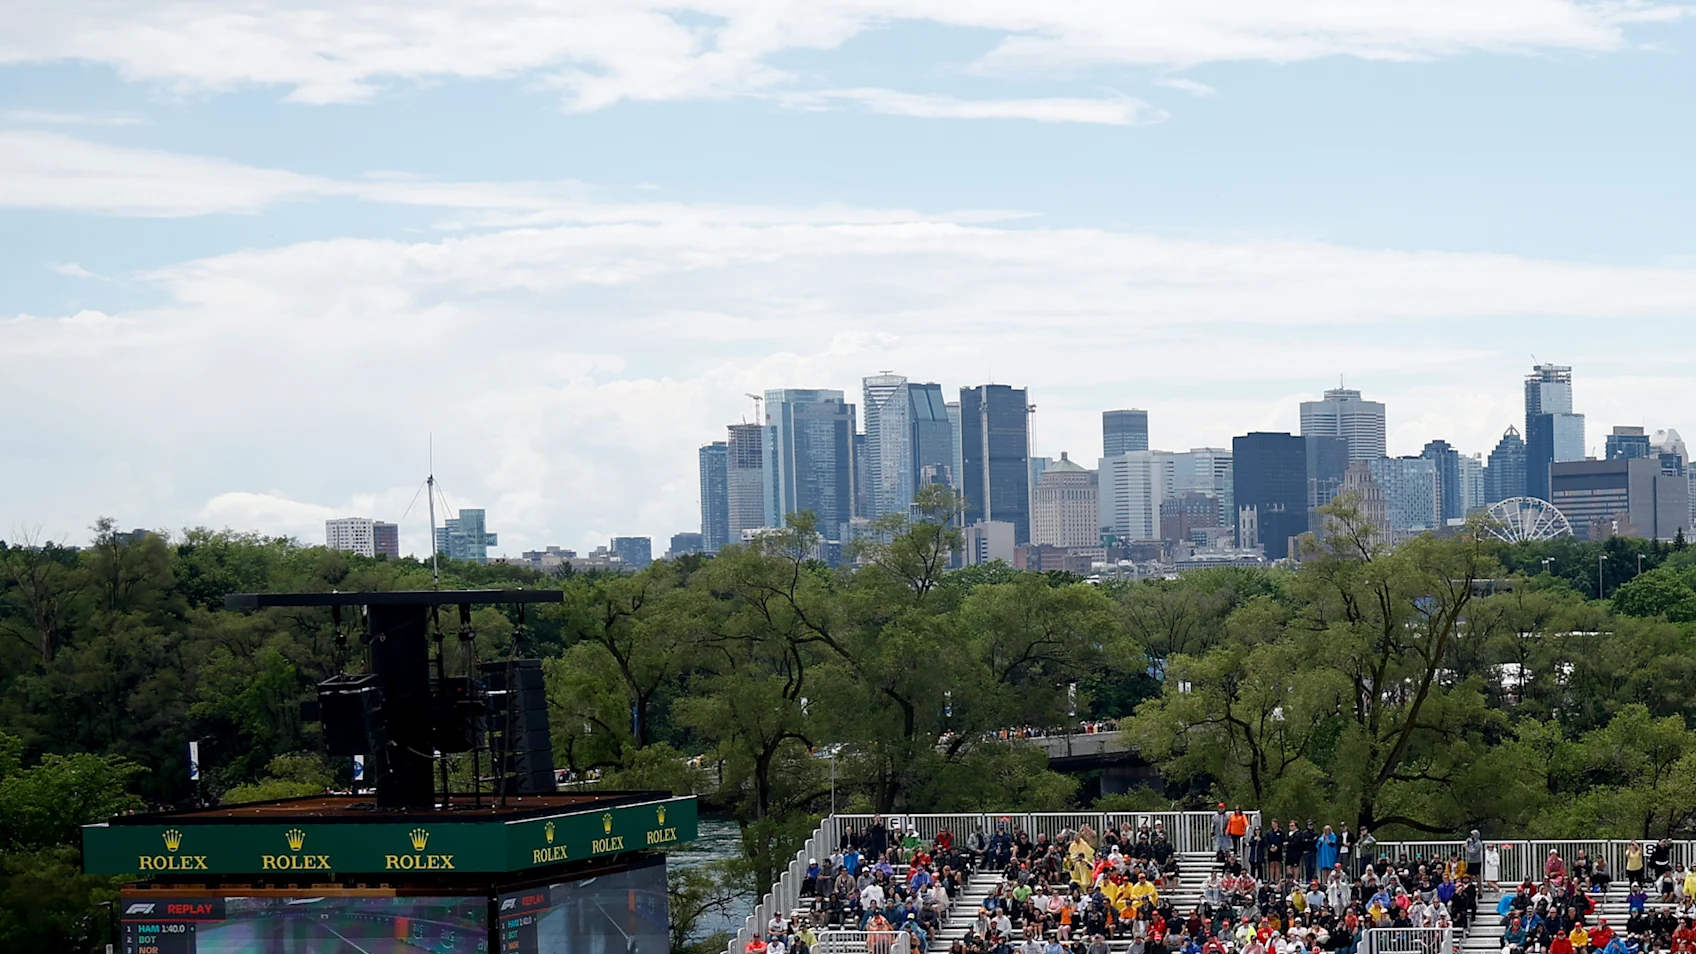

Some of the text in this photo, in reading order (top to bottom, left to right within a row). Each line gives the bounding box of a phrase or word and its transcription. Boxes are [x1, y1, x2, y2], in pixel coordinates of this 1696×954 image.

[646, 827, 678, 845] ROLEX
[592, 836, 625, 854] ROLEX
[533, 845, 568, 864] ROLEX
[139, 855, 208, 870] ROLEX
[261, 855, 331, 870] ROLEX
[385, 855, 455, 870] ROLEX
[167, 904, 212, 914] REPLAY
[162, 925, 185, 933] 1:40.0
